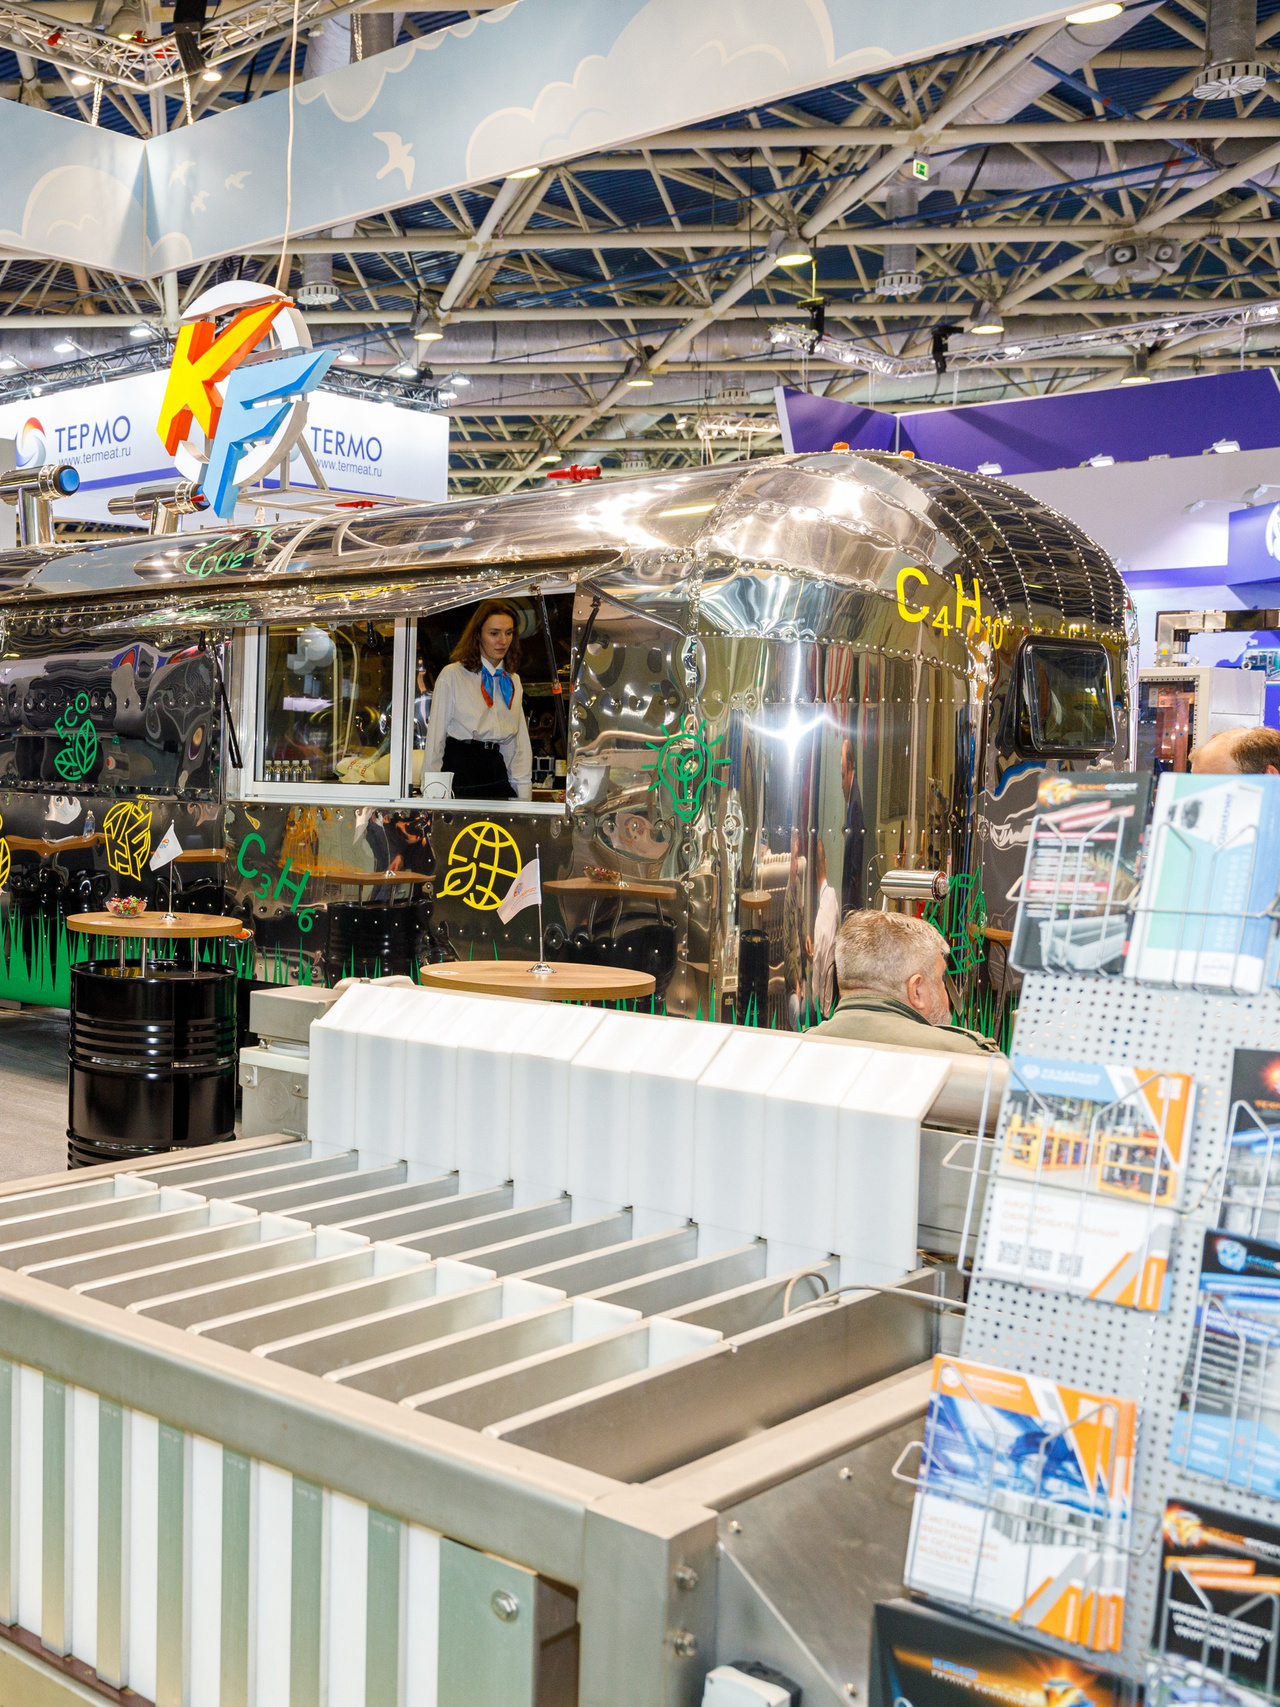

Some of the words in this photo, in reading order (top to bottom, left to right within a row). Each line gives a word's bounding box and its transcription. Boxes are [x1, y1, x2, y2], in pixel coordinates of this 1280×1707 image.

[55, 415, 131, 454] ТЕРМО
[310, 426, 383, 462] TERMO
[59, 446, 132, 467] www.termeat.ru
[54, 692, 89, 739] ECO
